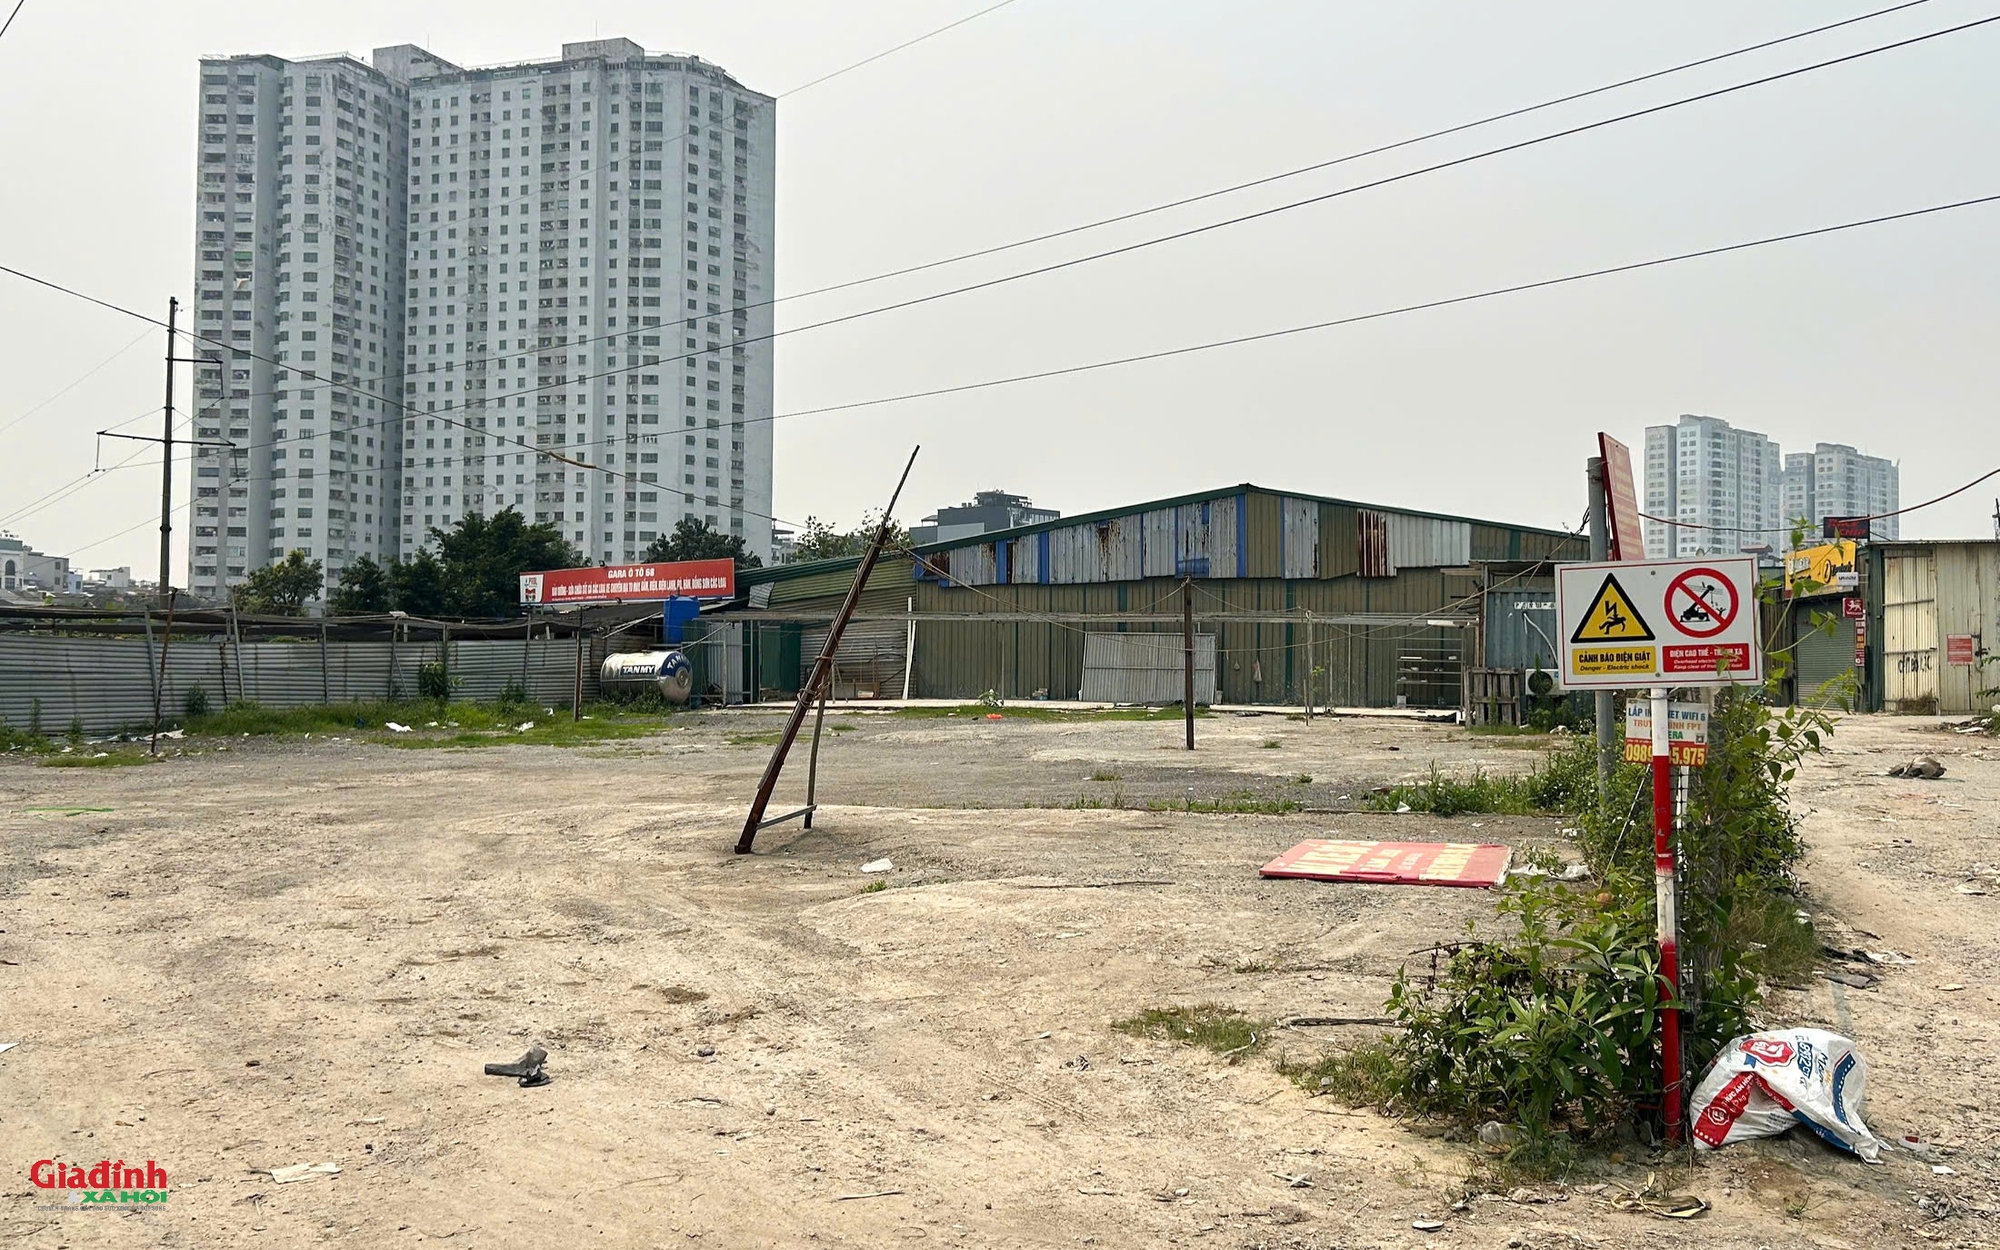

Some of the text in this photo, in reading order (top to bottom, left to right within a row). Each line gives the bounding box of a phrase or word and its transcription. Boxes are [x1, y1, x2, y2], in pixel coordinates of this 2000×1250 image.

[608, 567, 654, 578] GARA Ô TÔ 68
[1579, 650, 1650, 663] CẢNH BÁO ĐIỆN GIẬT
[1670, 649, 1684, 658] ĐIỆN
[1698, 647, 1709, 656] THẾ
[1629, 705, 1642, 716] LẮP
[1682, 711, 1698, 720] WIFI
[1701, 713, 1706, 721] 6
